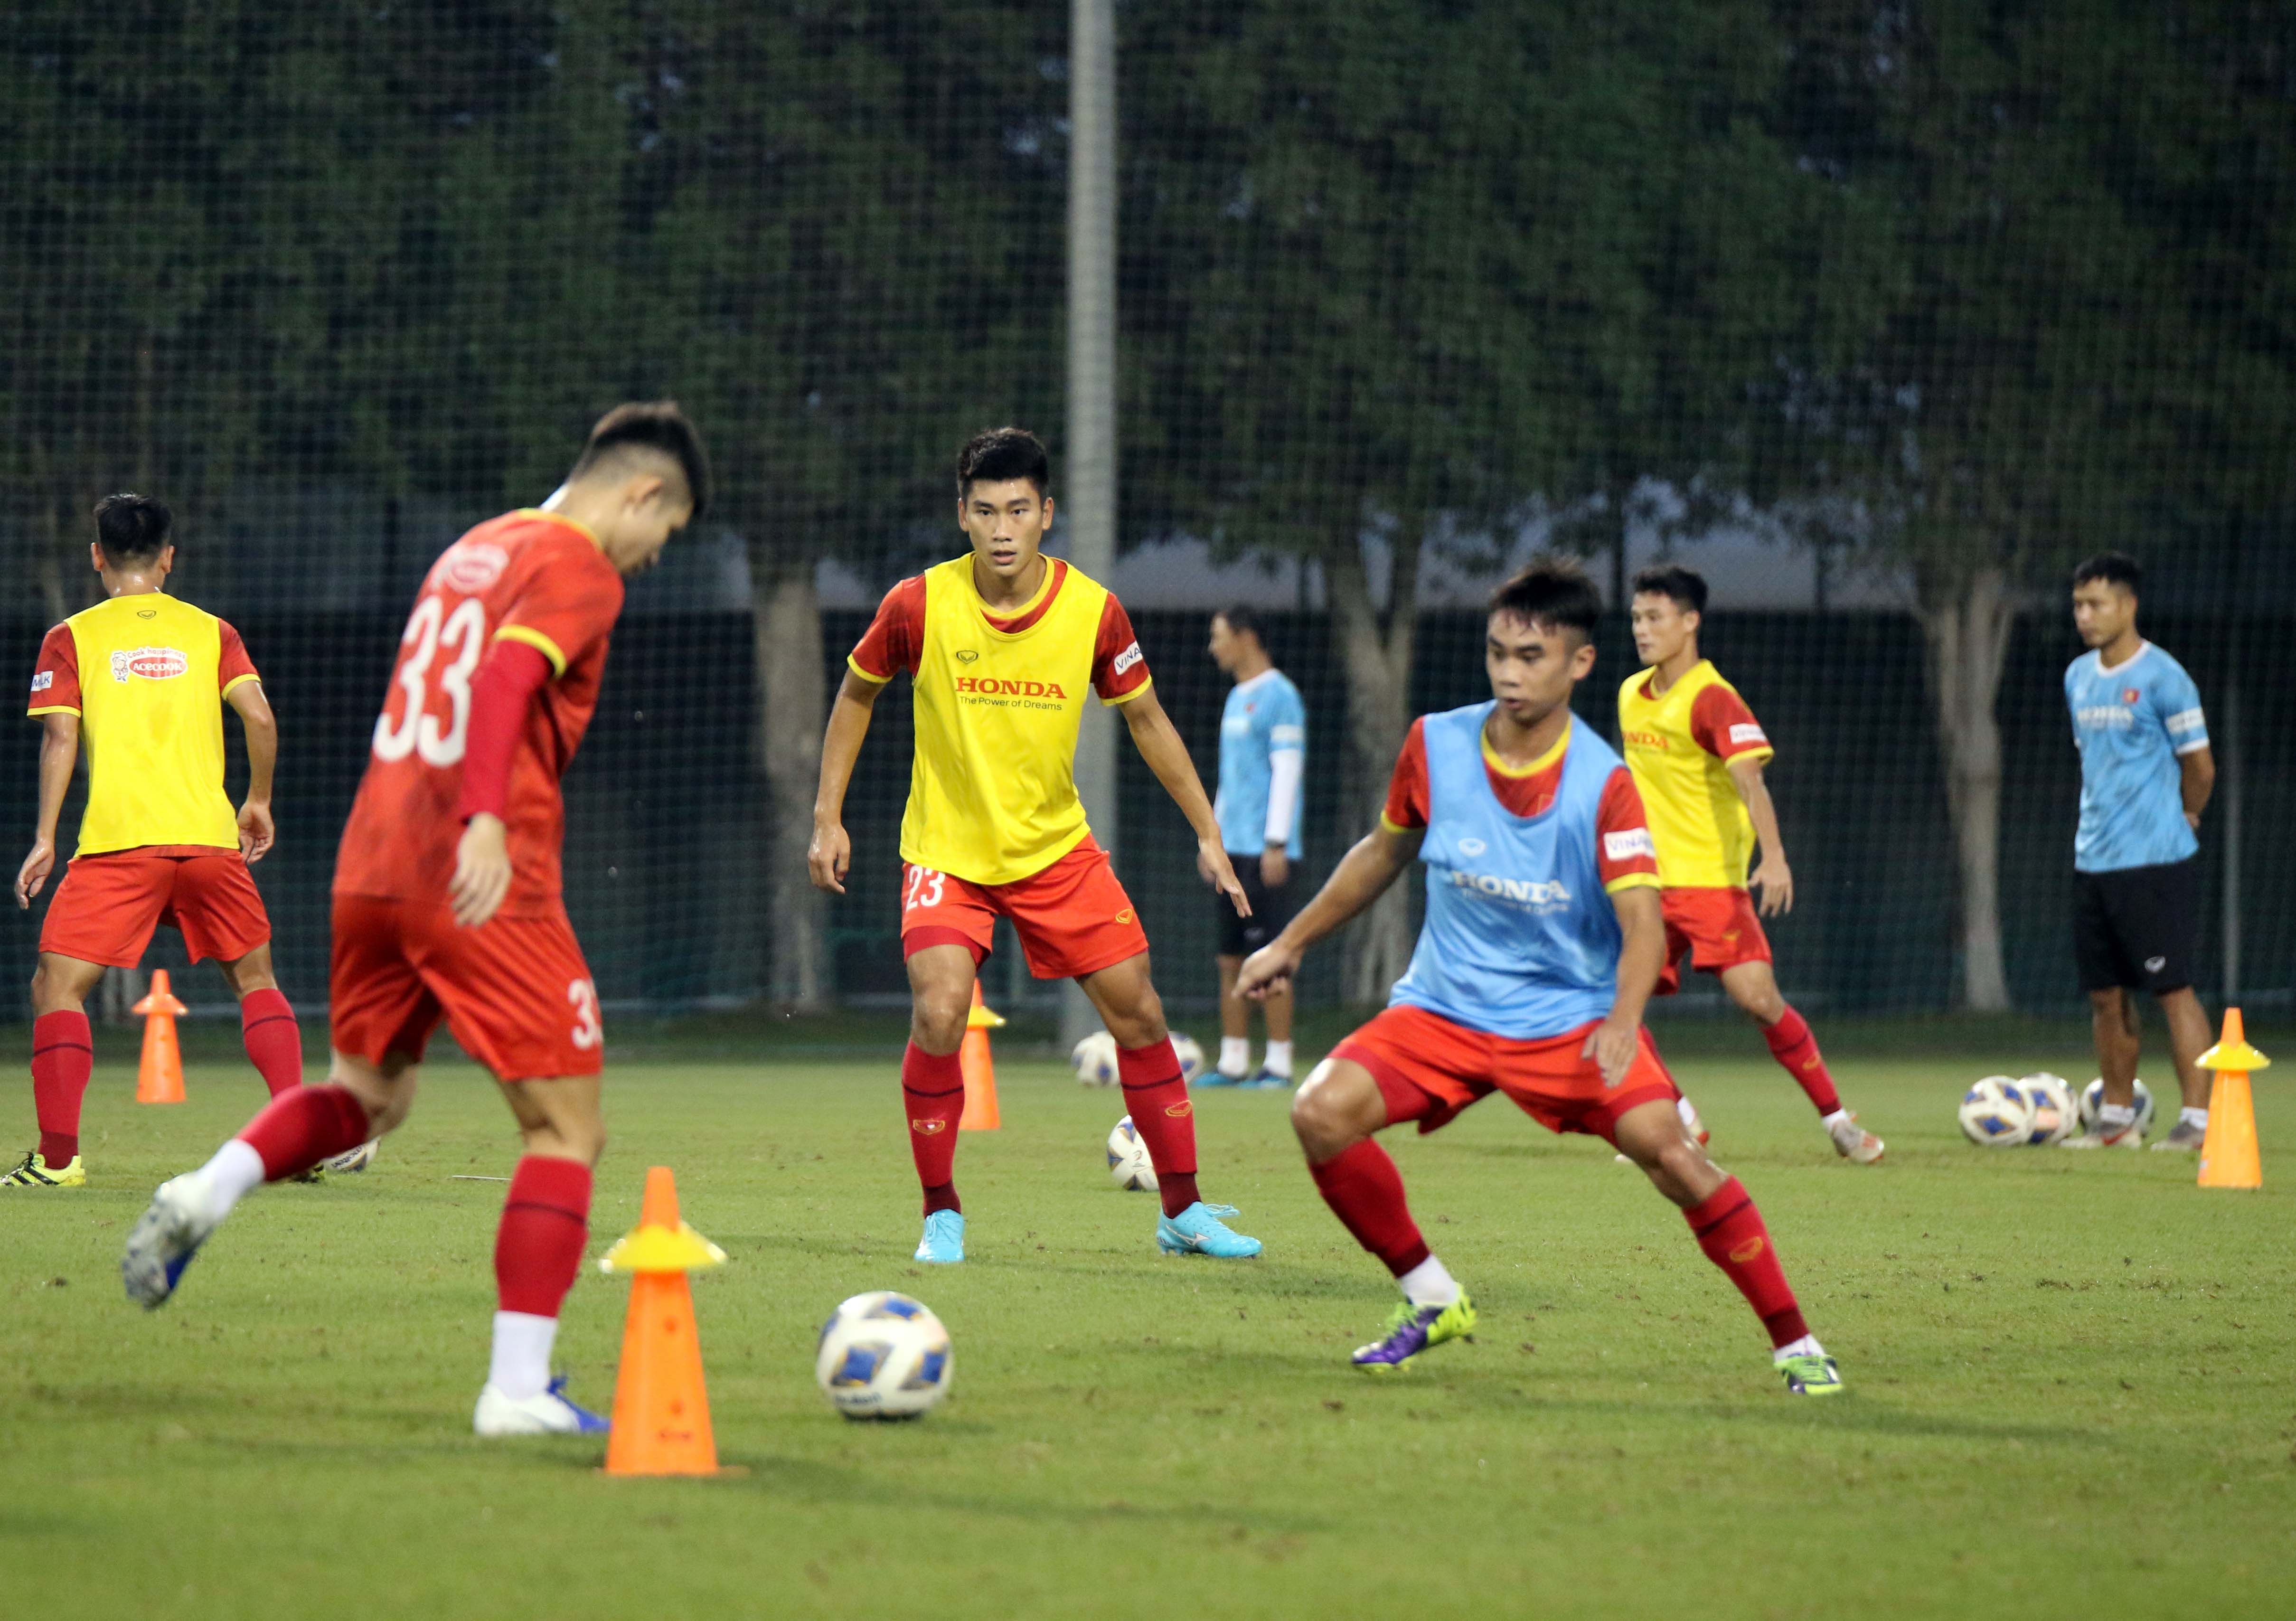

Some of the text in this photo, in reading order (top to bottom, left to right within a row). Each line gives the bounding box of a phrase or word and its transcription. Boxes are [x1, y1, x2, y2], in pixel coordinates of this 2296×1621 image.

[127, 649, 145, 659] Cook
[372, 595, 486, 768] 33
[955, 677, 1067, 699] HONDA
[960, 696, 976, 705] The
[979, 697, 1009, 707] Power
[1024, 700, 1063, 711] Dreams
[1622, 732, 1669, 750] NDA
[906, 865, 946, 912] 23
[1452, 870, 1571, 904] HONDA
[568, 978, 603, 1051] 3
